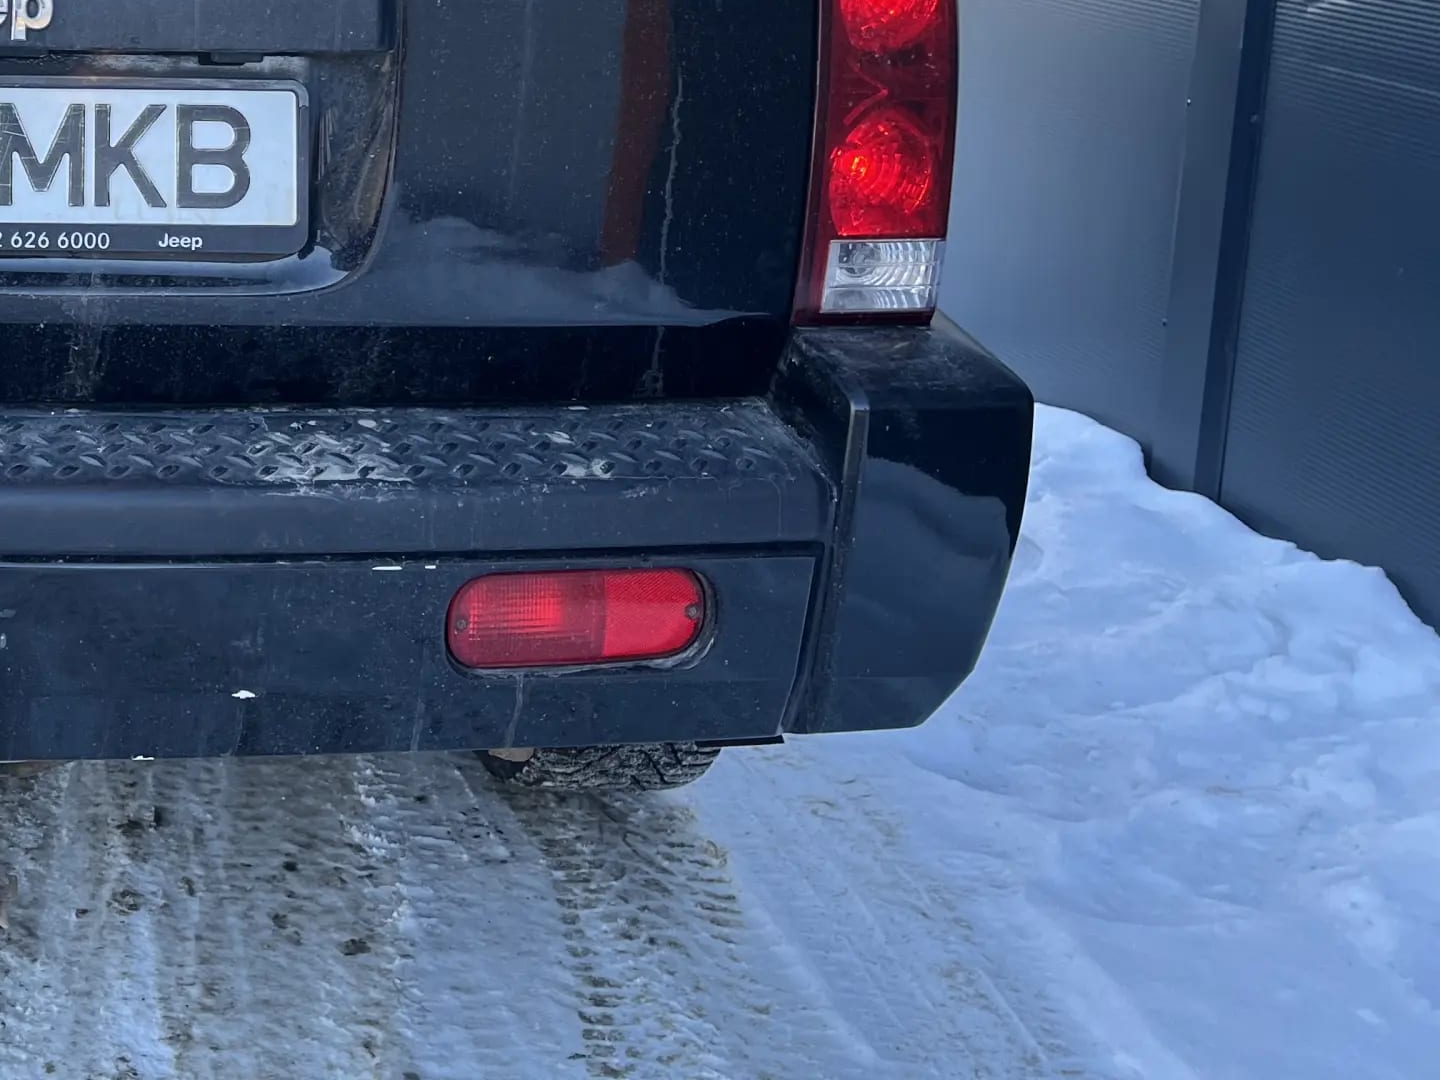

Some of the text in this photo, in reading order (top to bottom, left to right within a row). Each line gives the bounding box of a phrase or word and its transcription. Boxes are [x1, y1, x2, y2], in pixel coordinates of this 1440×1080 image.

[10, 231, 50, 249] 626
[57, 232, 110, 250] 6000
[158, 233, 203, 250] Jeep
